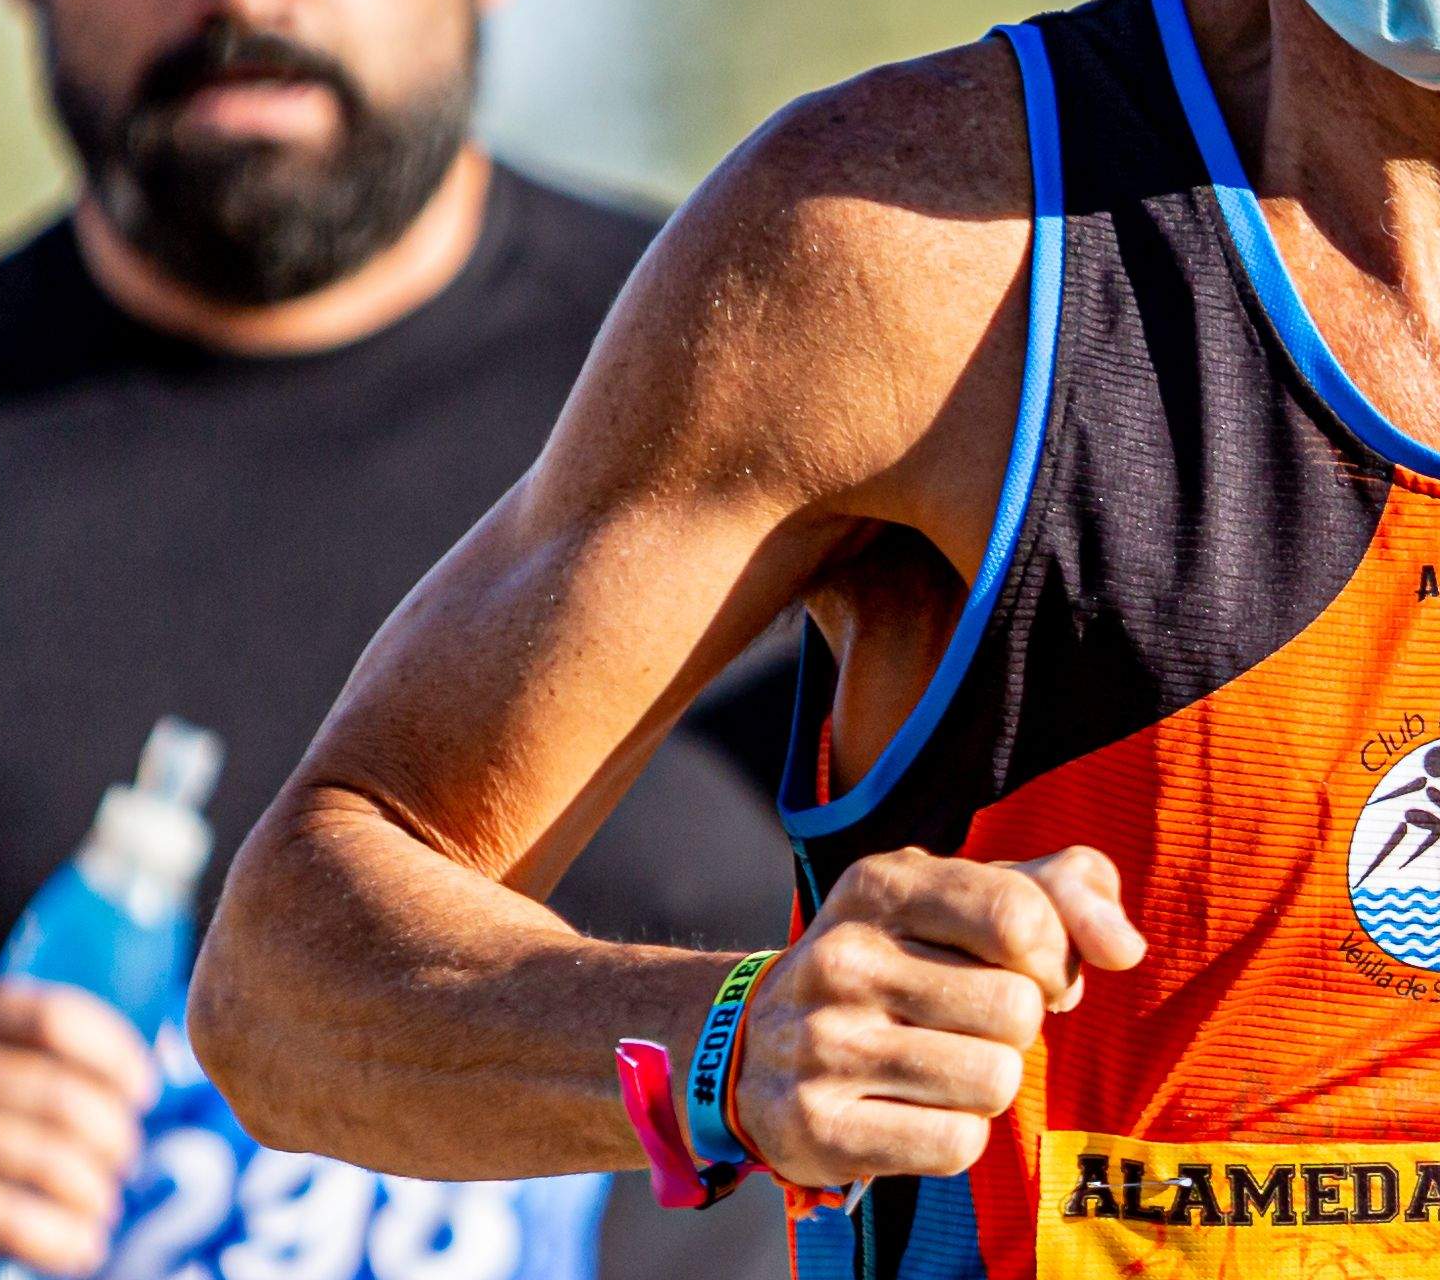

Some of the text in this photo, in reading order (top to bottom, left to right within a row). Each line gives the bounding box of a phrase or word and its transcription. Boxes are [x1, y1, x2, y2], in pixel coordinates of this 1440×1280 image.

[1360, 711, 1425, 772] Club
[1395, 974, 1427, 1001] de
[693, 958, 772, 1106] #CORRE
